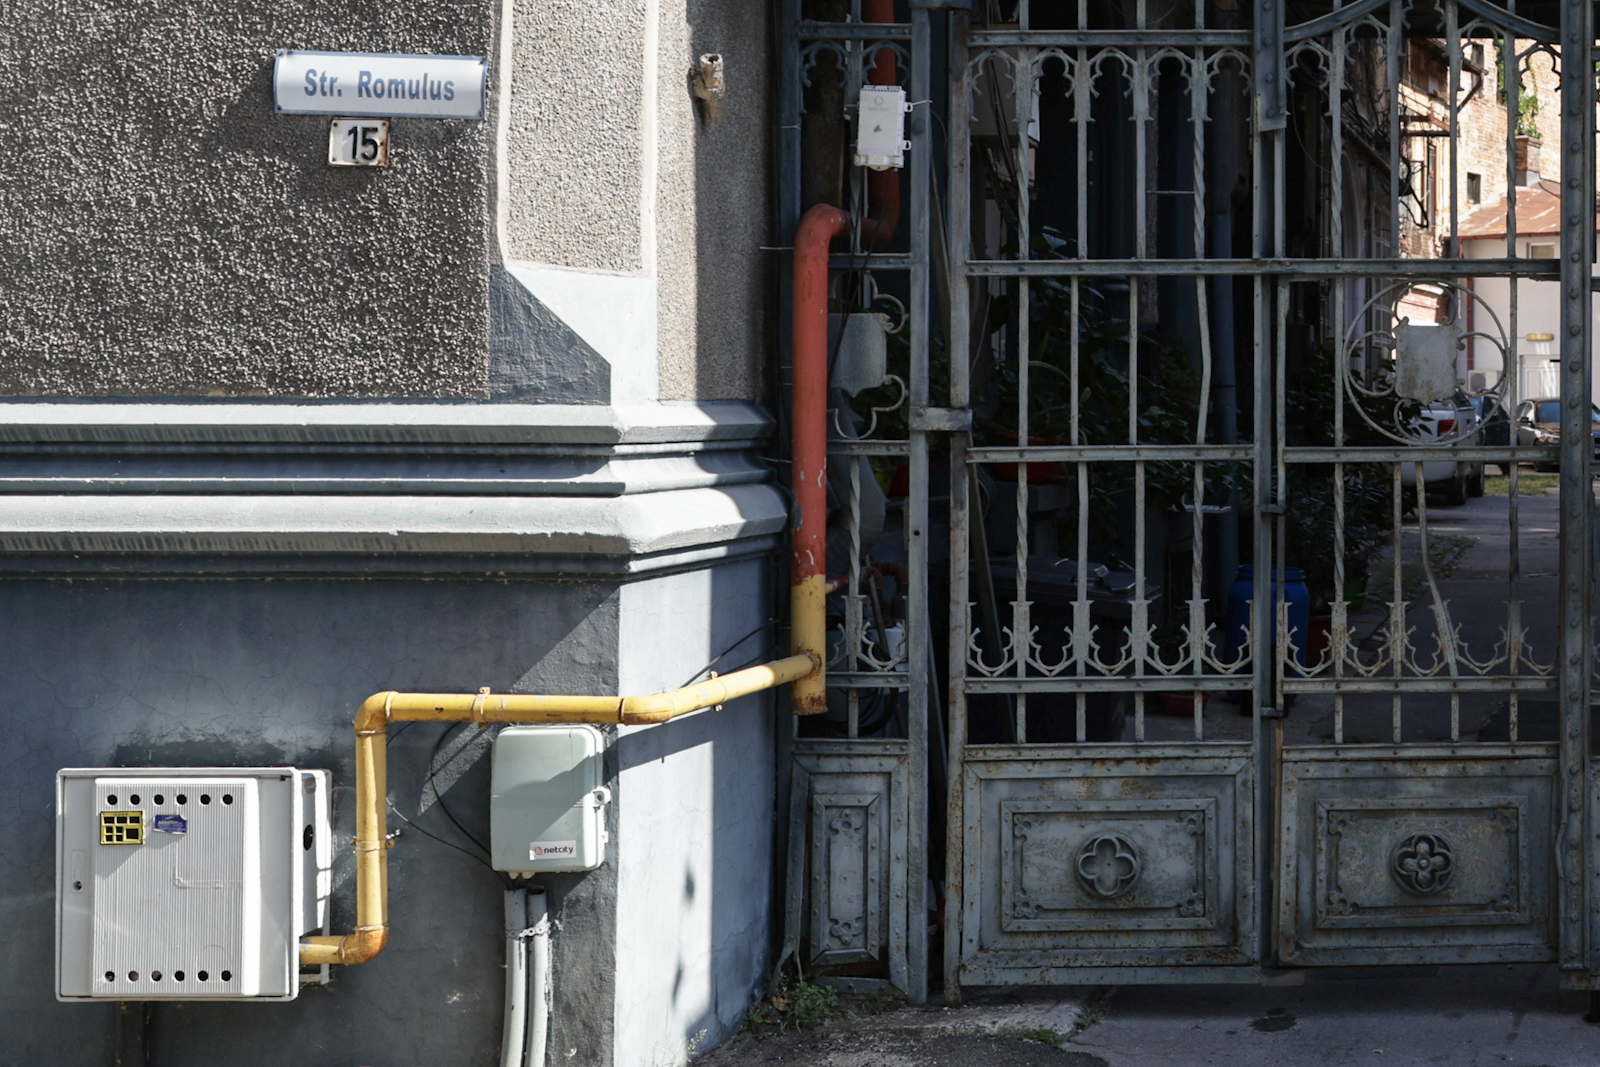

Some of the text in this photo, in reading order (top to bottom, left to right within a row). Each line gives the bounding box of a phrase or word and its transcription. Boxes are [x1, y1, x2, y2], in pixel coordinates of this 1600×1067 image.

[303, 69, 455, 101] Str. Romulus
[348, 126, 379, 161] 15
